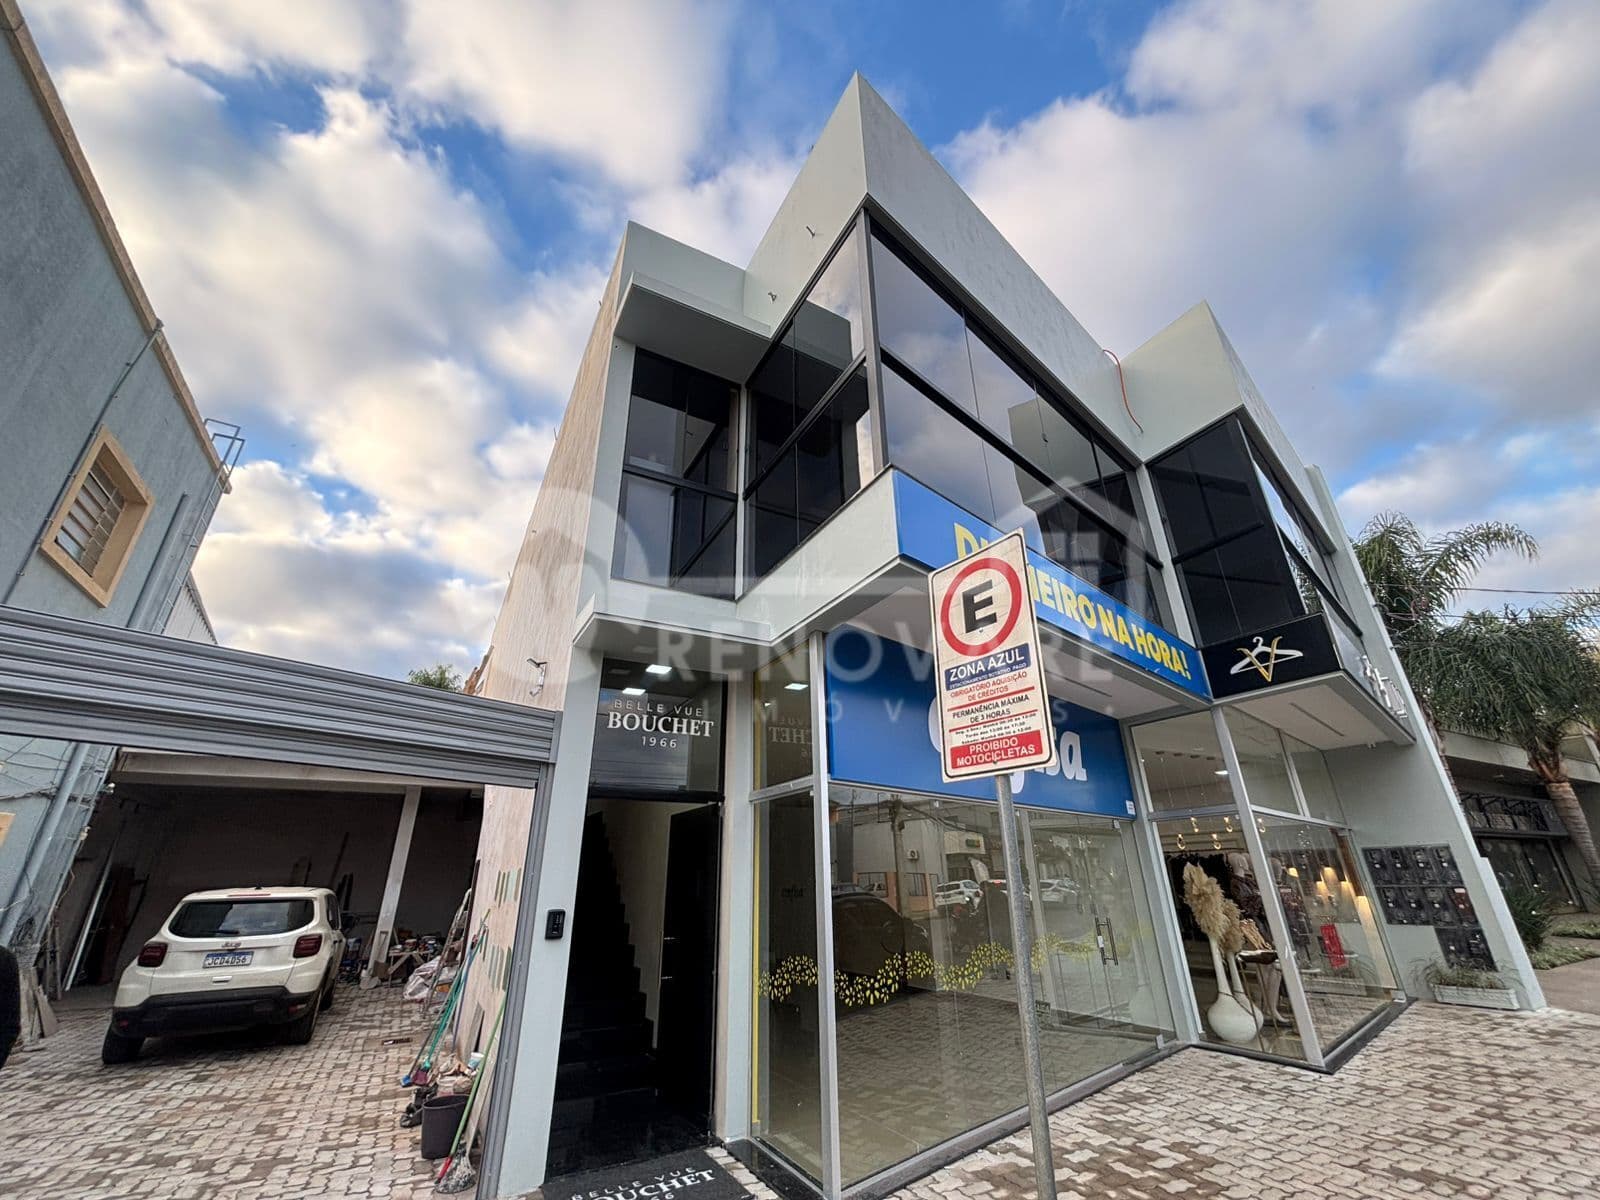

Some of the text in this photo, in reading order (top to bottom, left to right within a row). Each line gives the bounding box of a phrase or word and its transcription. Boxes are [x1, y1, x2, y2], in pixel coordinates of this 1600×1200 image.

[954, 522, 1192, 680] DEIRO NA HORA!
[961, 579, 997, 633] E
[950, 648, 1025, 682] ZONA AZUL
[950, 670, 1027, 698] OBRIGATÓRIO AQUISIÇÃO
[967, 684, 1009, 702] DE CRÉDITOS
[614, 699, 704, 717] BELLE VUE
[952, 694, 1030, 719] PERMANÊNCIA MÁXIMA
[970, 715, 979, 724] DE
[986, 708, 1011, 719] HORAS
[607, 711, 714, 738] BOUCHET
[641, 735, 678, 748] 1966
[969, 737, 1018, 755] PROIBIDO
[957, 744, 1036, 767] MOTOCICLETAS
[654, 1167, 696, 1182] VUE
